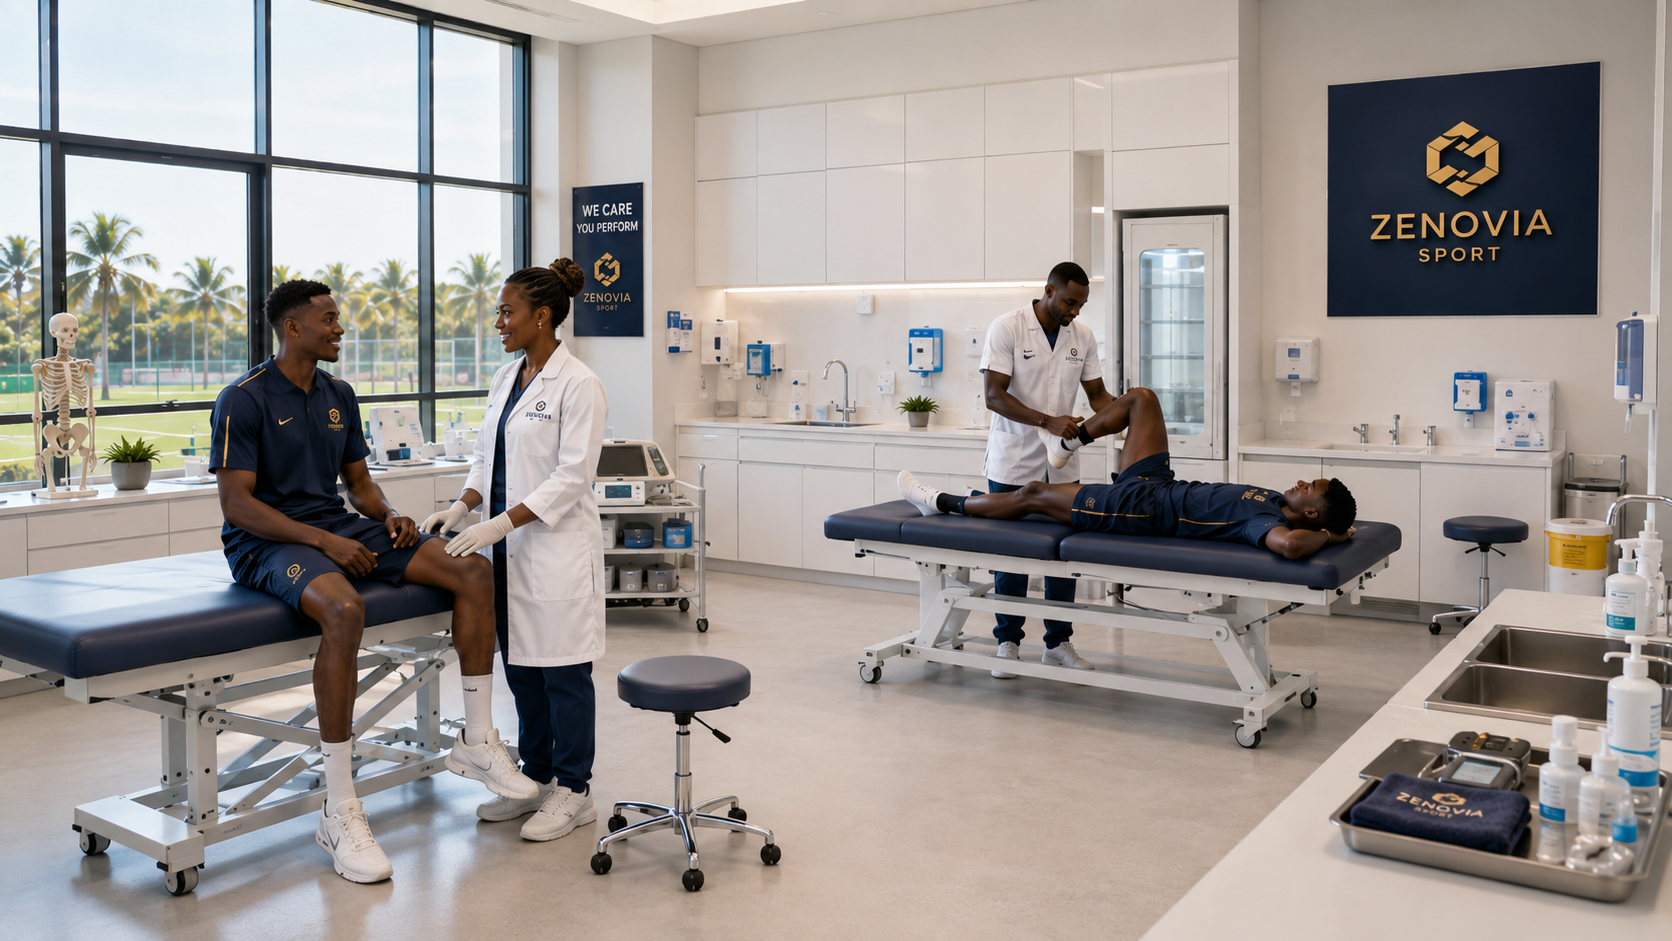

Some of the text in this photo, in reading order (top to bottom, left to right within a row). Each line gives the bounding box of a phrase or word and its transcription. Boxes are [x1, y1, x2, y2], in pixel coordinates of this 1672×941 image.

[582, 203, 632, 217] WE CARE
[576, 221, 638, 234] YOU PERFORM
[1370, 209, 1552, 240] ZENOVIA
[1419, 246, 1500, 263] SPORT
[583, 292, 631, 303] ZENOVIA
[596, 304, 618, 312] SPORT
[1396, 791, 1484, 818] ZENOVIA
